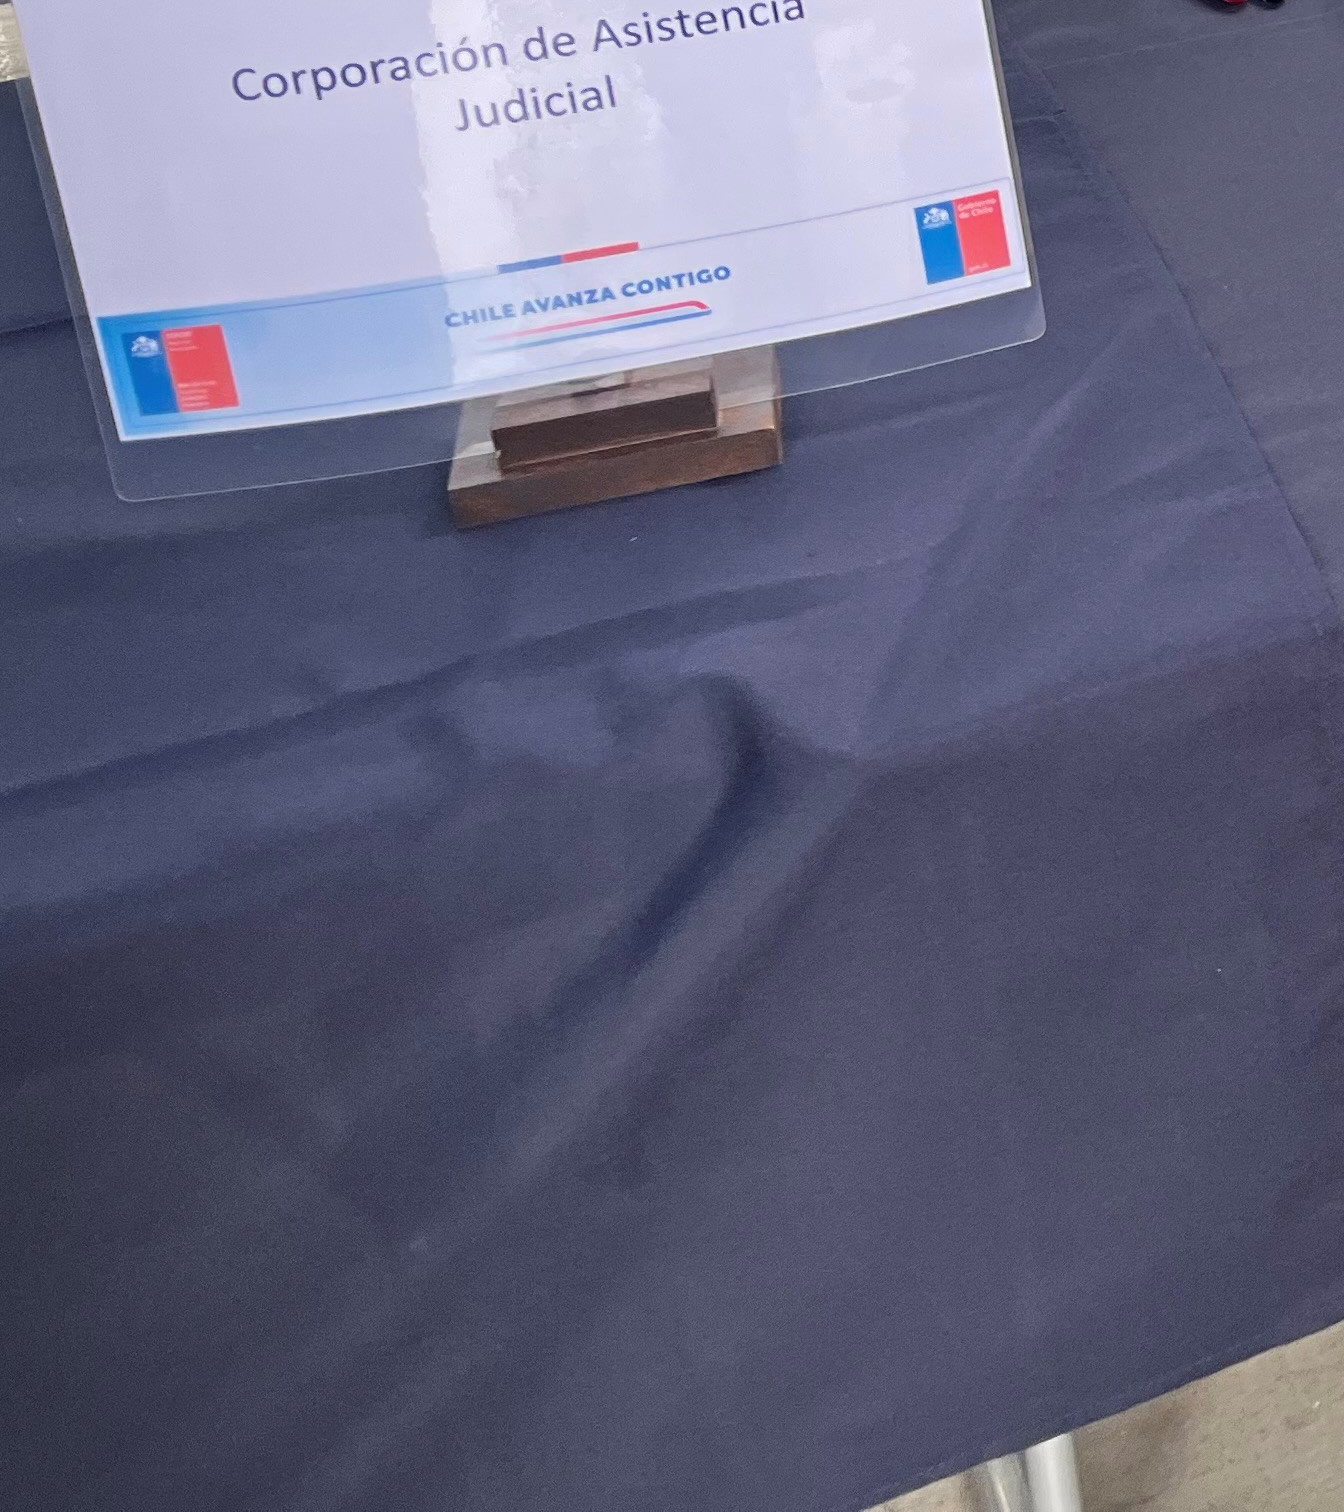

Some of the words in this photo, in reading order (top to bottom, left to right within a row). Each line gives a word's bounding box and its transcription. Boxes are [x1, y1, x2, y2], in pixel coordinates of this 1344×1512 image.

[231, 36, 508, 101] Corporación
[523, 25, 577, 62] de
[454, 74, 617, 132] Judicial
[444, 303, 517, 328] CHILE
[521, 287, 616, 316] AVANZA
[622, 265, 731, 298] CONTIGO
